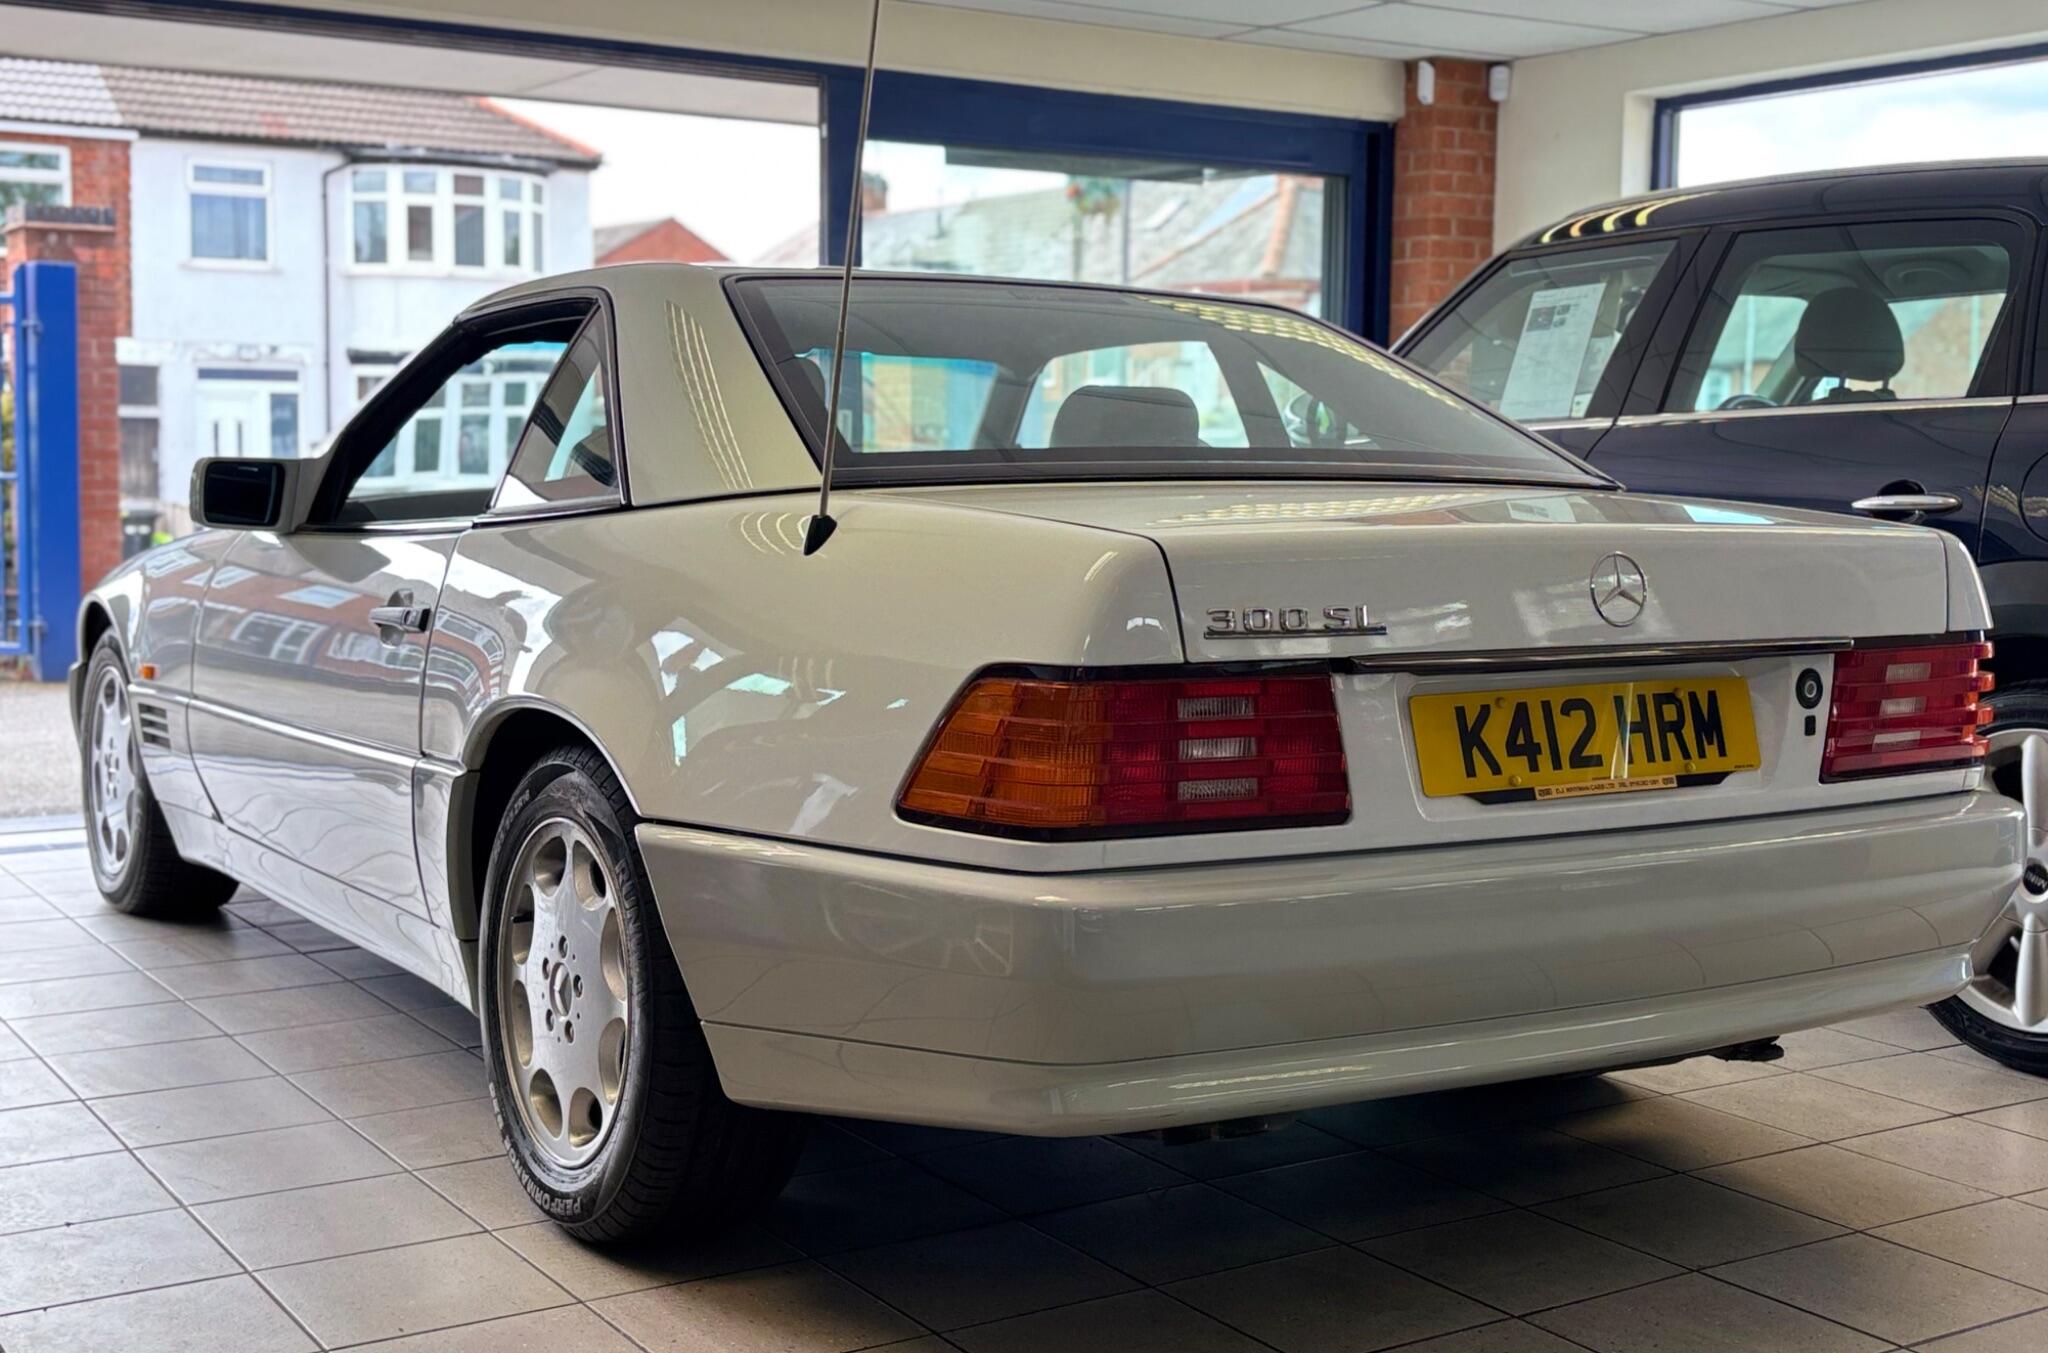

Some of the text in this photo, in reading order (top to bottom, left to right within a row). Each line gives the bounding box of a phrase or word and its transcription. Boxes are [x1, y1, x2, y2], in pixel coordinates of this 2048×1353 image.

[1206, 605, 1386, 632] 300 SL
[1455, 689, 1727, 778] K412 HRM
